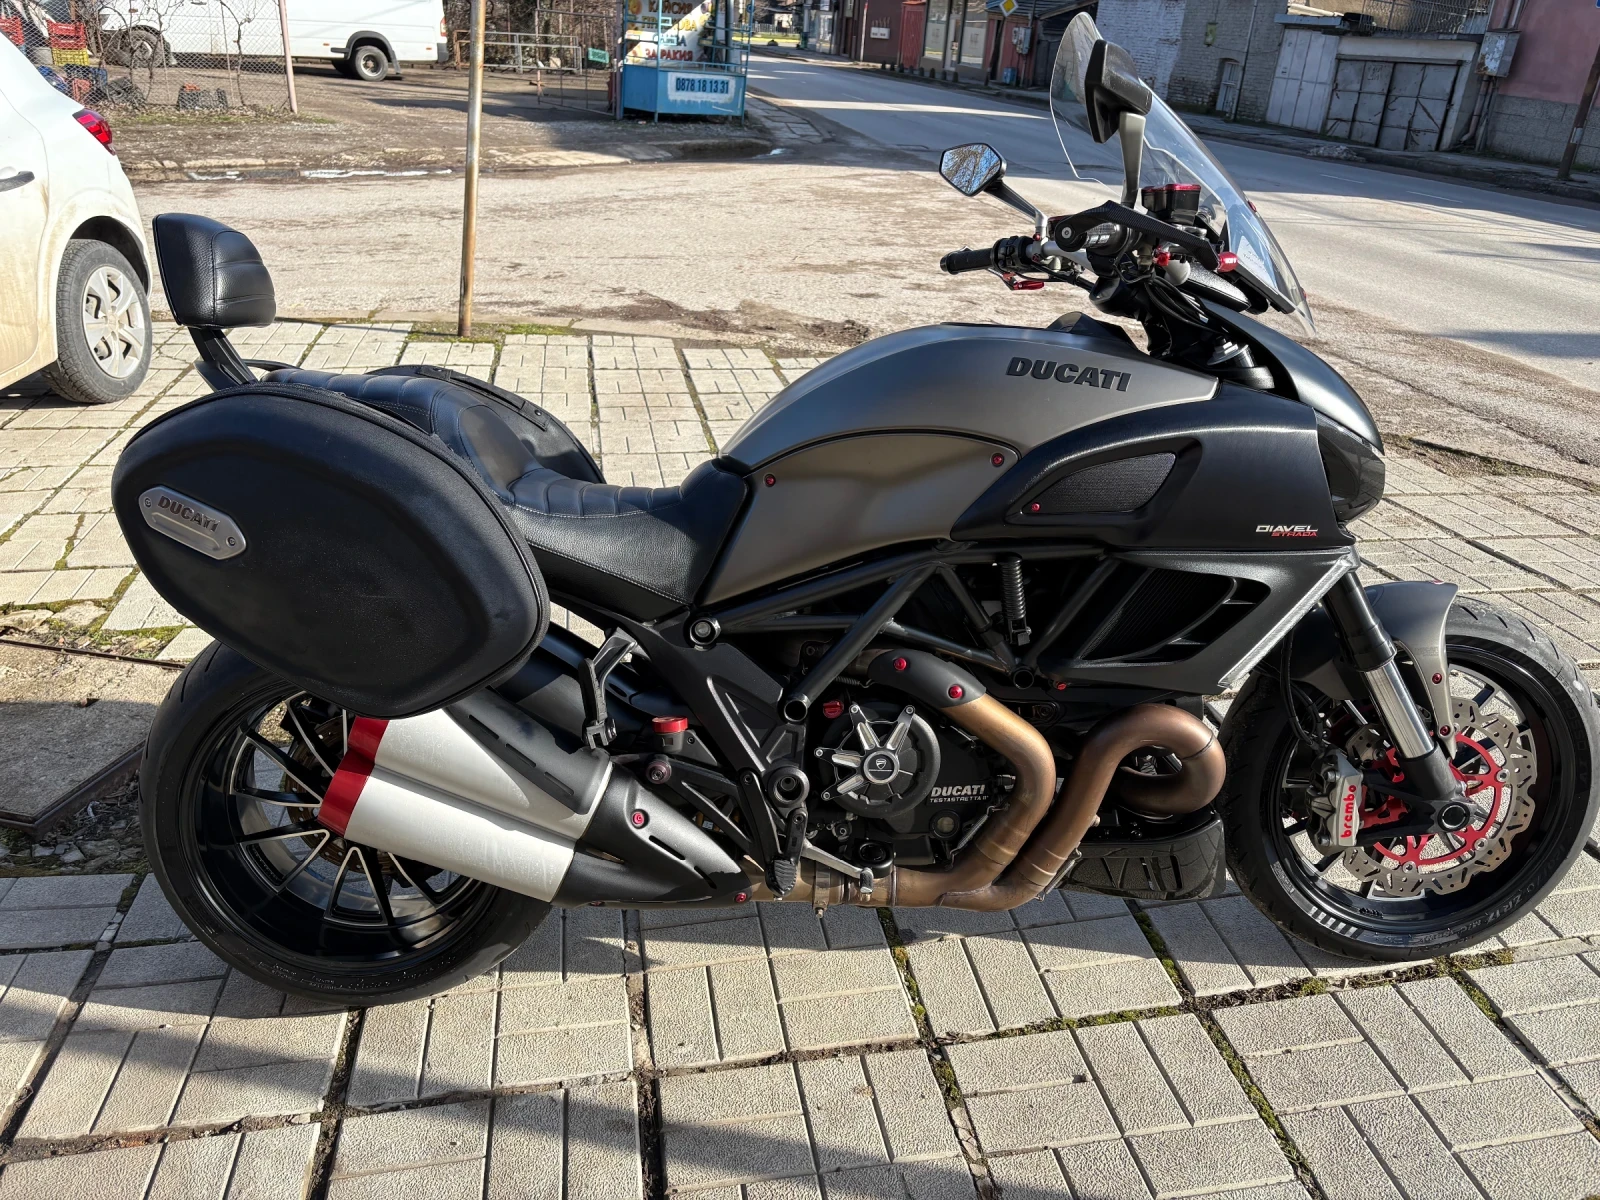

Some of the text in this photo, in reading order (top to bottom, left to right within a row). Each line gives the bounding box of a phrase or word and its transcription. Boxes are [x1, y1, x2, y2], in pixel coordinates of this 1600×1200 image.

[641, 16, 698, 31] ПРСКОВА
[660, 48, 693, 62] РАКИЯ
[675, 77, 729, 94] 0878 18 13 31
[1005, 356, 1133, 392] DUCATI
[157, 495, 220, 533] DUCATI
[1255, 524, 1318, 533] DIAVEL
[931, 784, 986, 798] DUCATI
[1340, 784, 1357, 838] brembo
